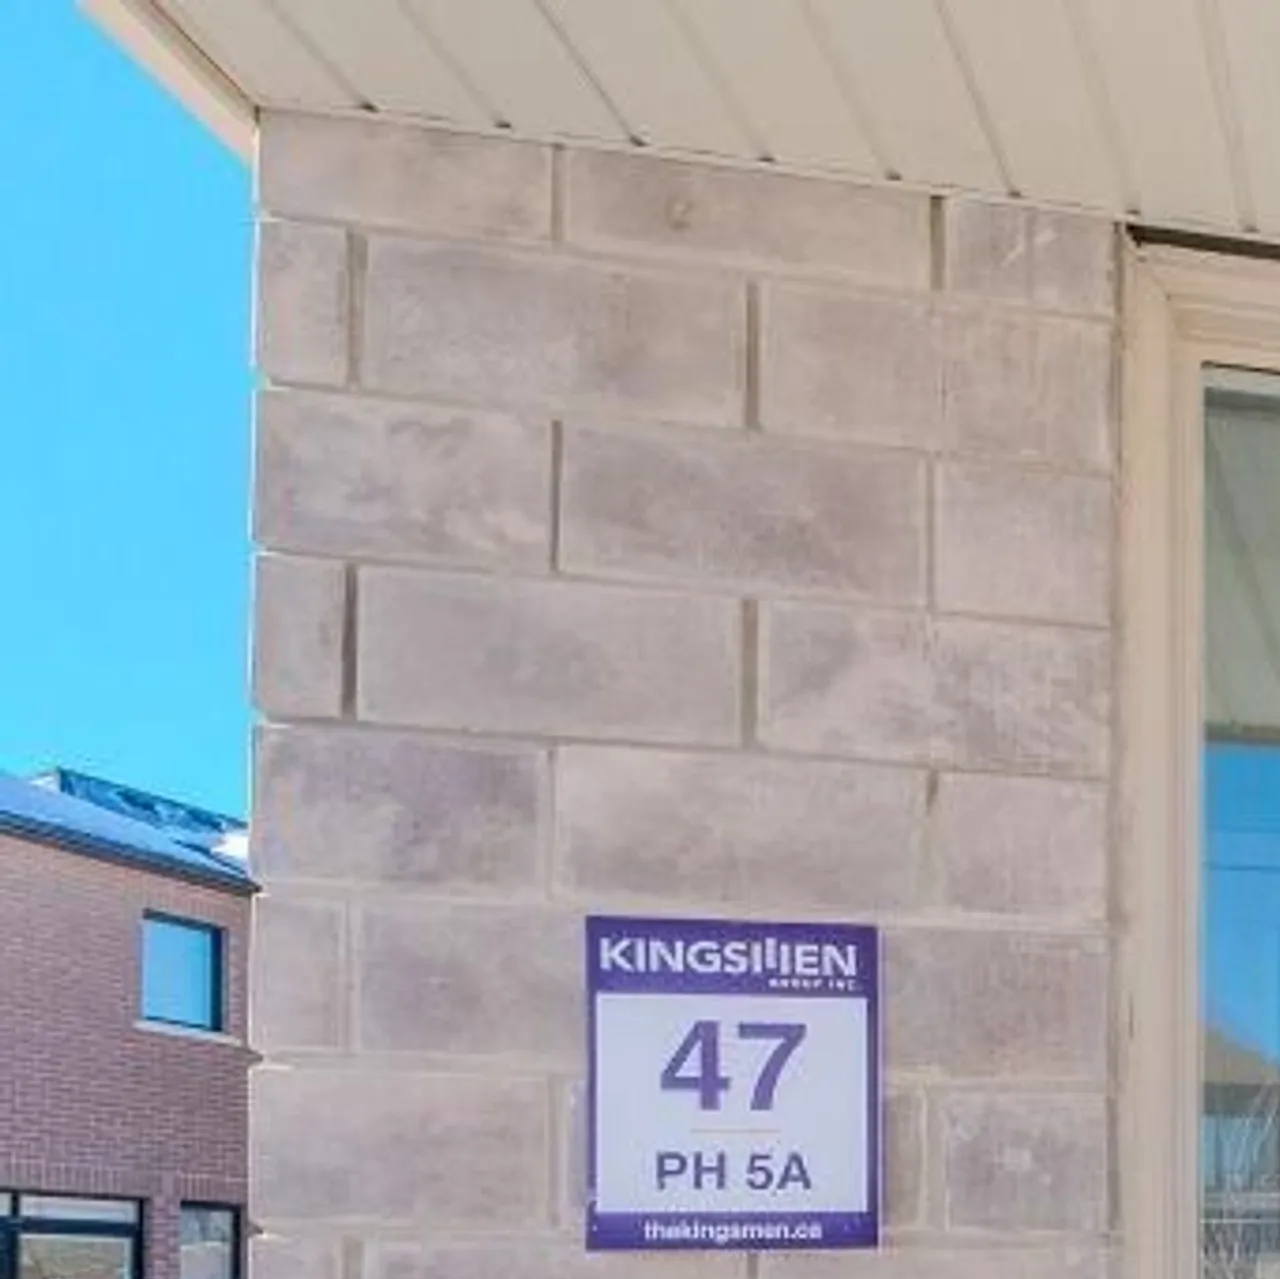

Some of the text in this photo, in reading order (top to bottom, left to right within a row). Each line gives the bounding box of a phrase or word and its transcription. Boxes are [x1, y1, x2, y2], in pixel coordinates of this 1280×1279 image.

[660, 1019, 807, 1112] 47
[656, 1151, 813, 1191] PH 5A
[644, 1218, 823, 1245] thekingsmen.ca
